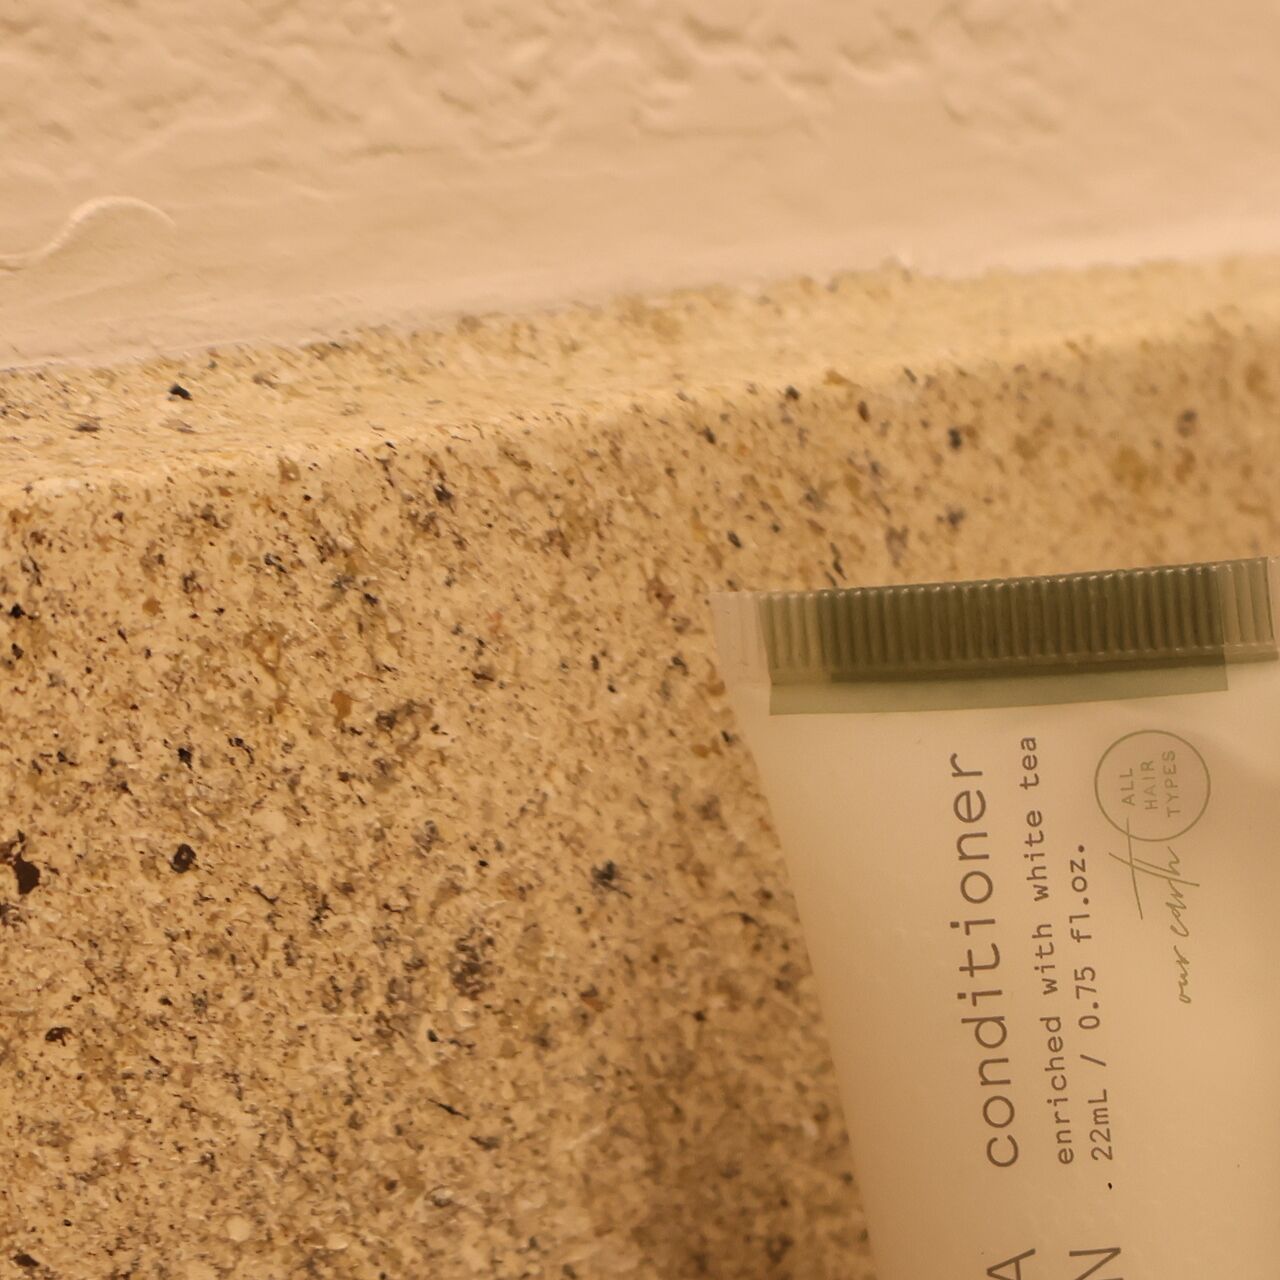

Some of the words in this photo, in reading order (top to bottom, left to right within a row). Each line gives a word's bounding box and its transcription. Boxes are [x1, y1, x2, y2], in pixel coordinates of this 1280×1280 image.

[1016, 736, 1041, 790] tea
[1120, 768, 1136, 807] ALL
[1141, 759, 1158, 810] HAIR
[1162, 750, 1181, 817] TYPES
[1022, 809, 1050, 901] white
[1068, 843, 1092, 943] fl.oz.
[947, 751, 1020, 1170] conditioner
[1031, 922, 1060, 994] with
[1074, 965, 1103, 1031] 0.75
[1040, 1015, 1076, 1164] enriched
[1080, 1055, 1107, 1067] /
[1085, 1087, 1115, 1161] 22mL
